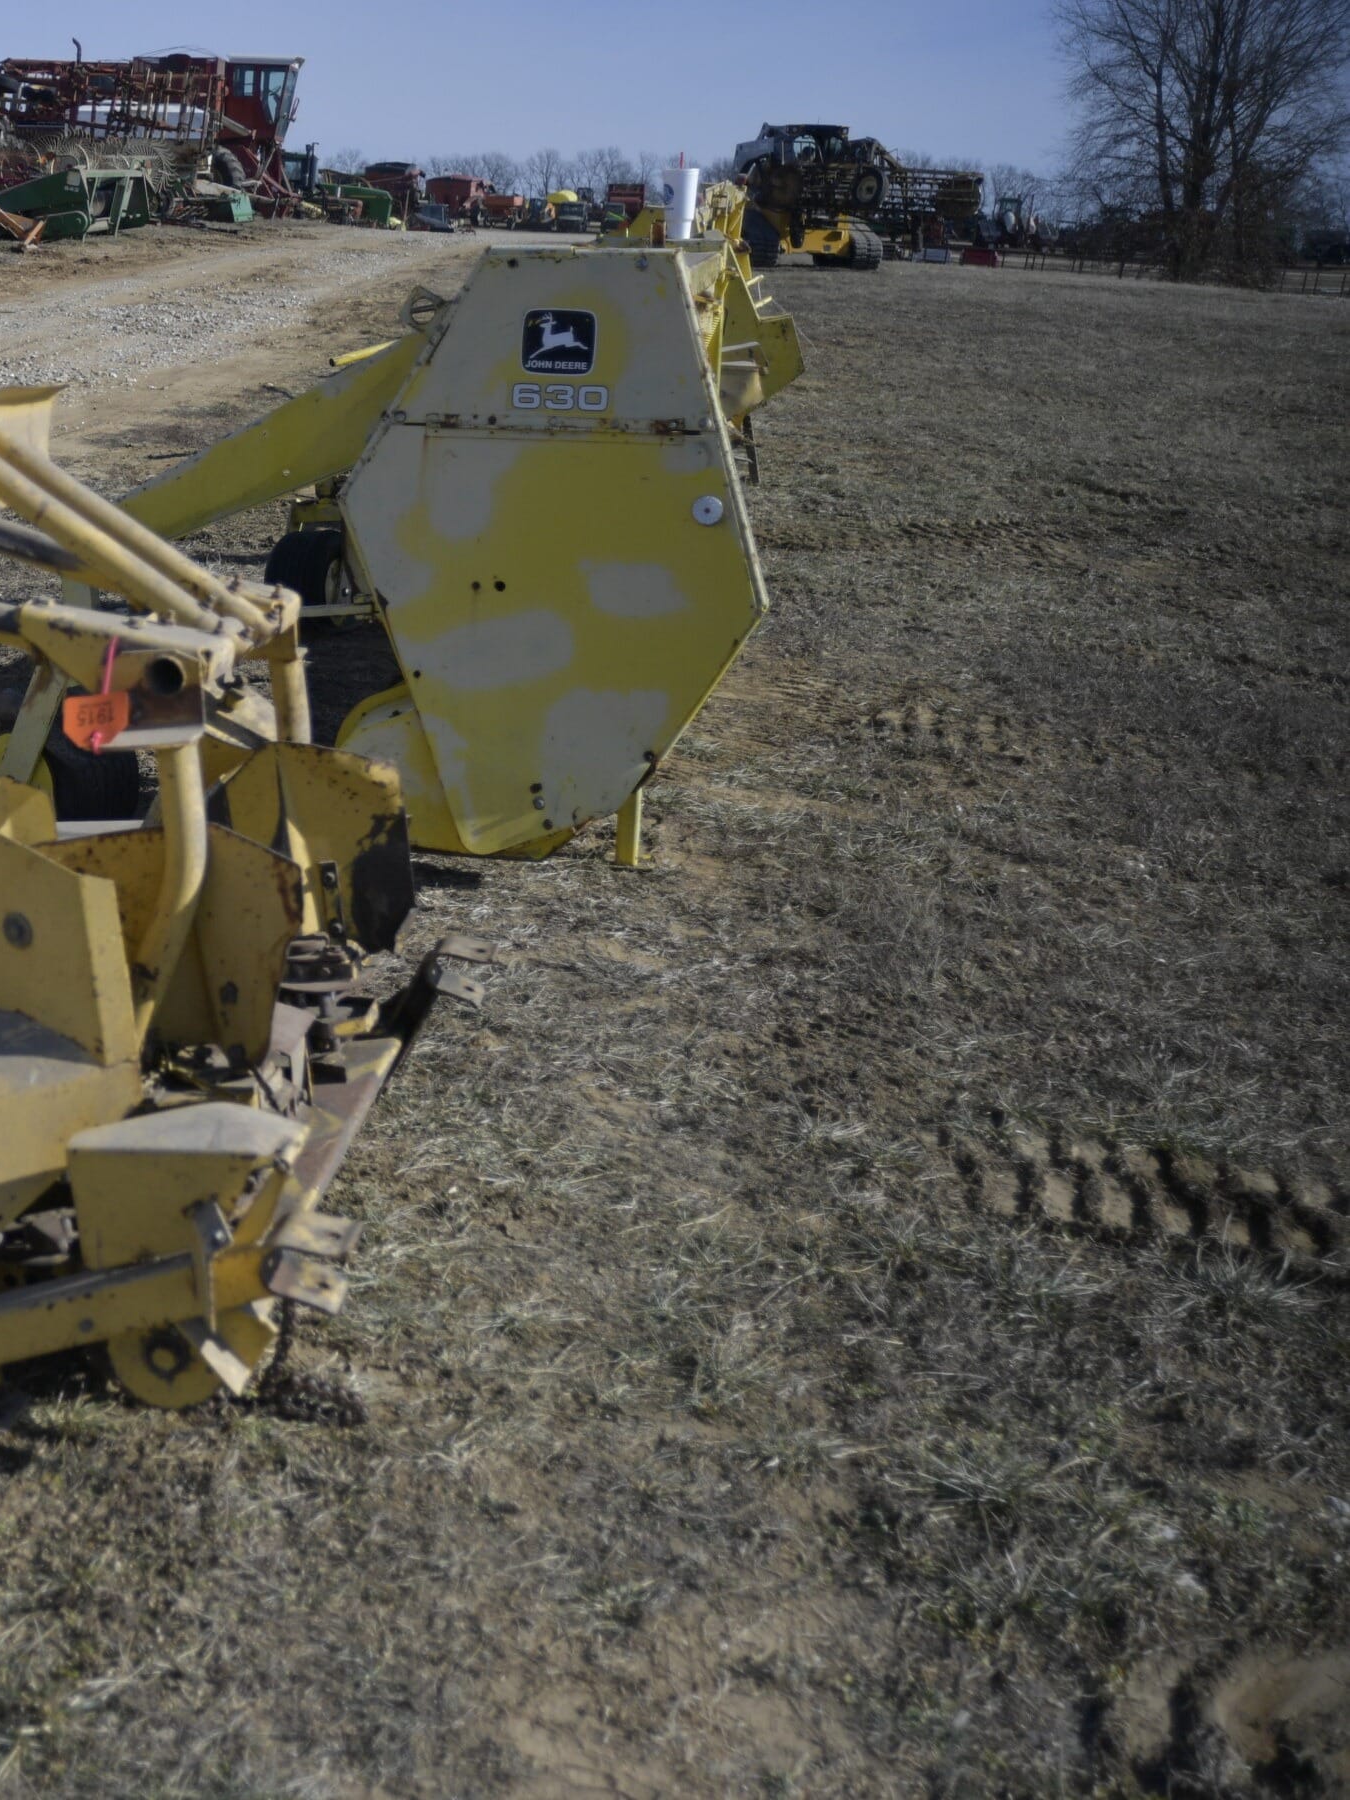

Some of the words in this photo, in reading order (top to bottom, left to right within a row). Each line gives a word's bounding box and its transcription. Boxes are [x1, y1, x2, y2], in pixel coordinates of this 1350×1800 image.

[525, 360, 552, 369] JOHN
[554, 361, 588, 370] DEERE
[512, 383, 609, 412] 630
